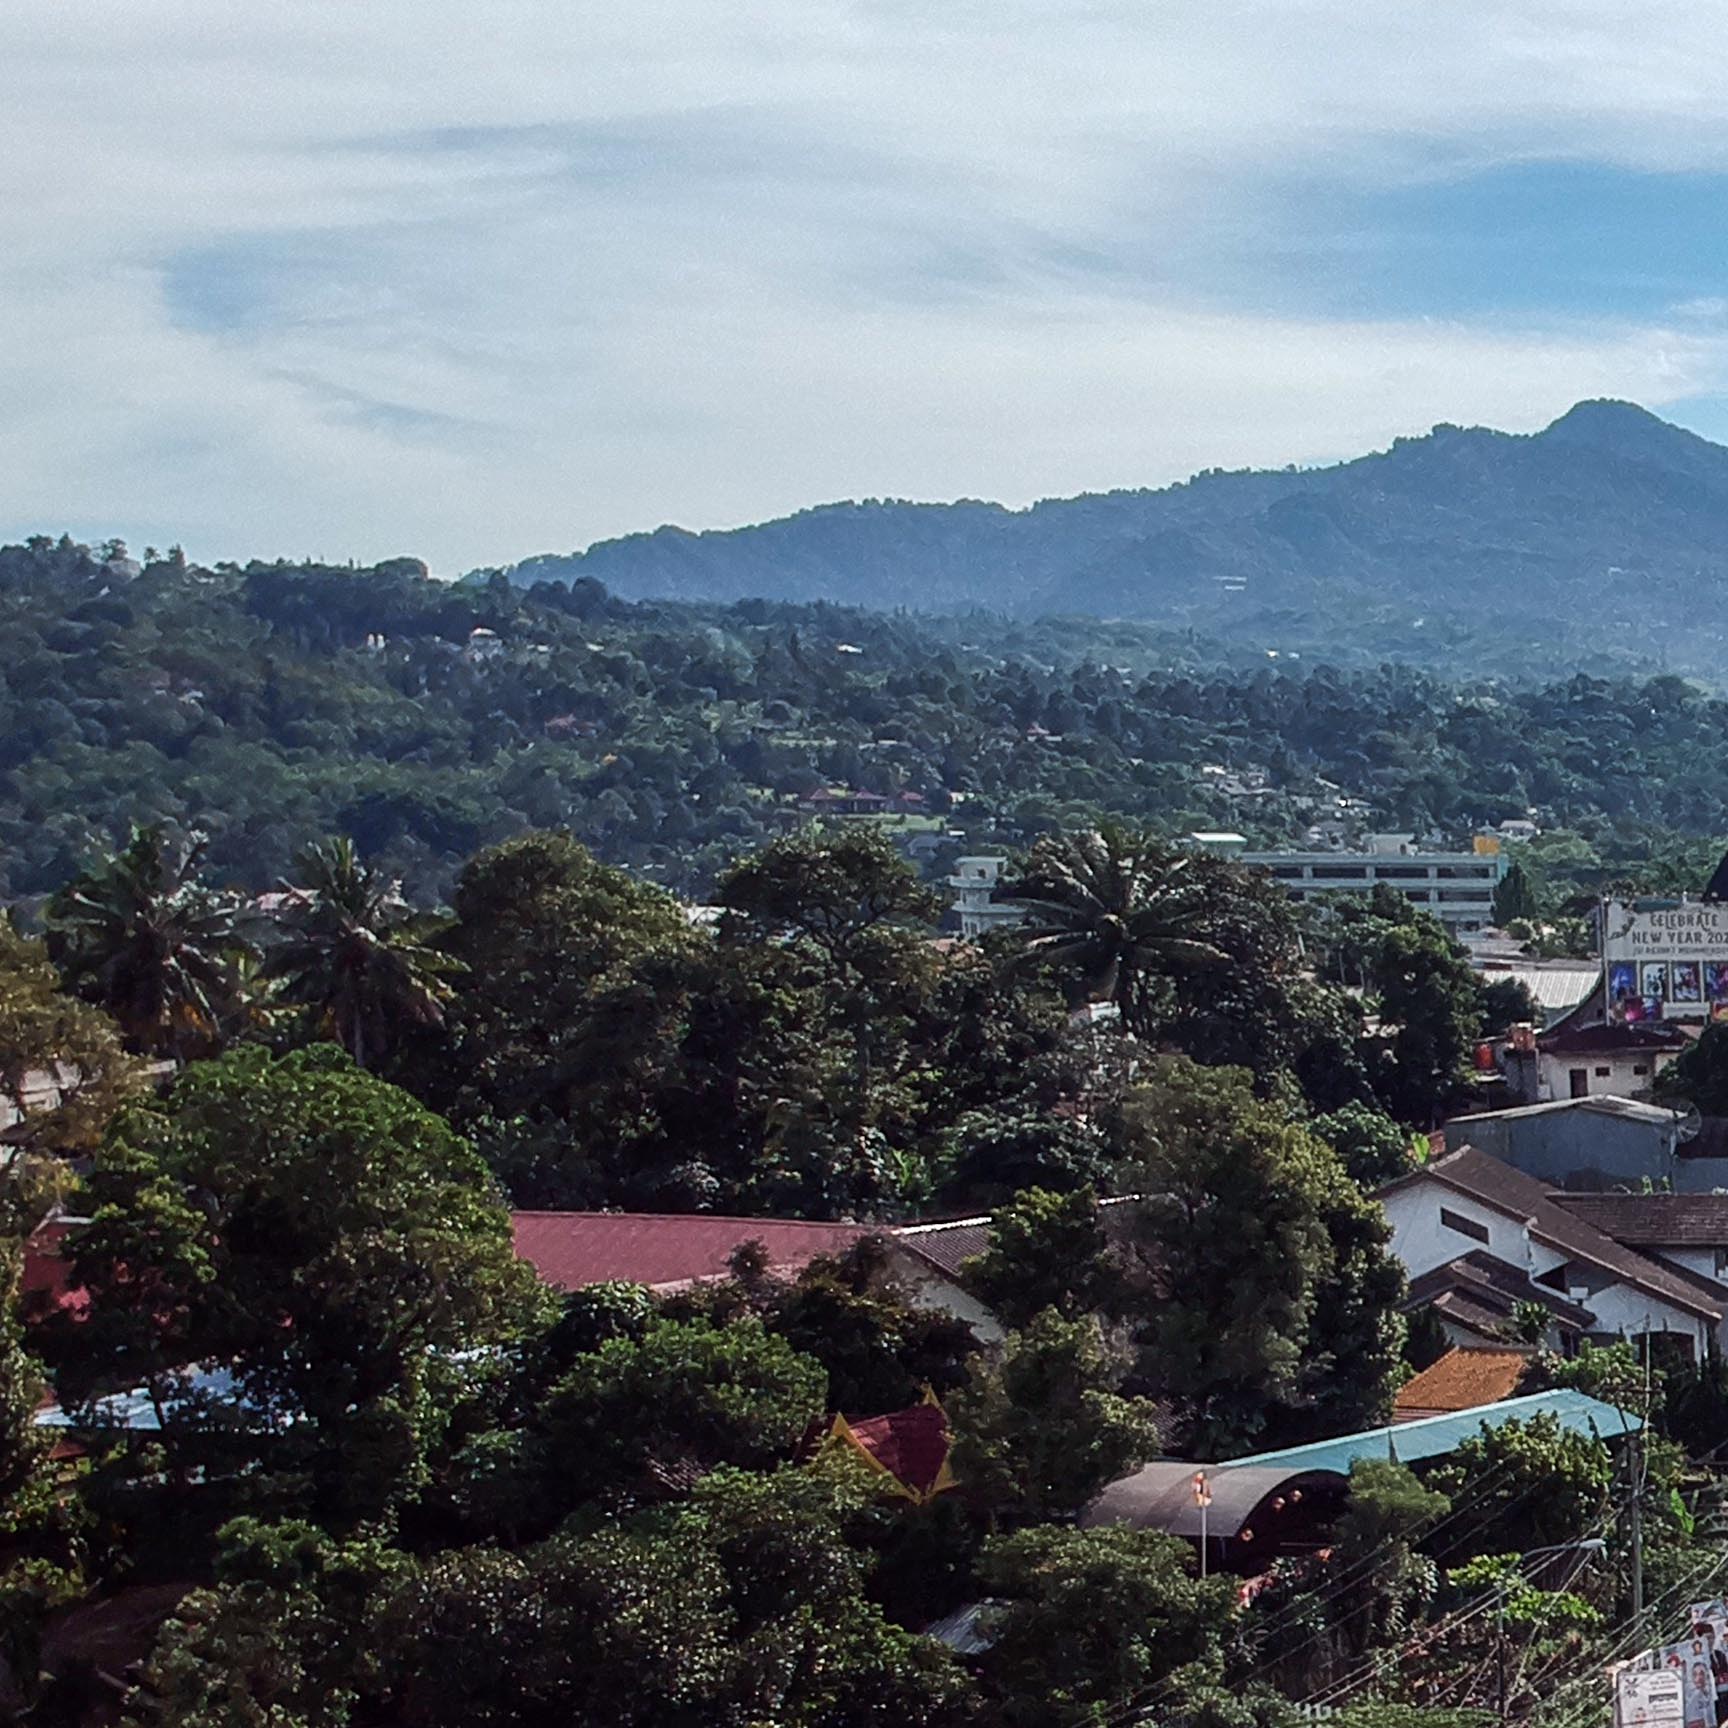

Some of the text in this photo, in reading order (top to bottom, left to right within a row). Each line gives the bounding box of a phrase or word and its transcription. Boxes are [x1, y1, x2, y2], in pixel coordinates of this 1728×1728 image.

[1650, 911, 1720, 933] CELEBRATE
[1632, 933, 1662, 945] NEW
[1666, 931, 1702, 945] YEAR
